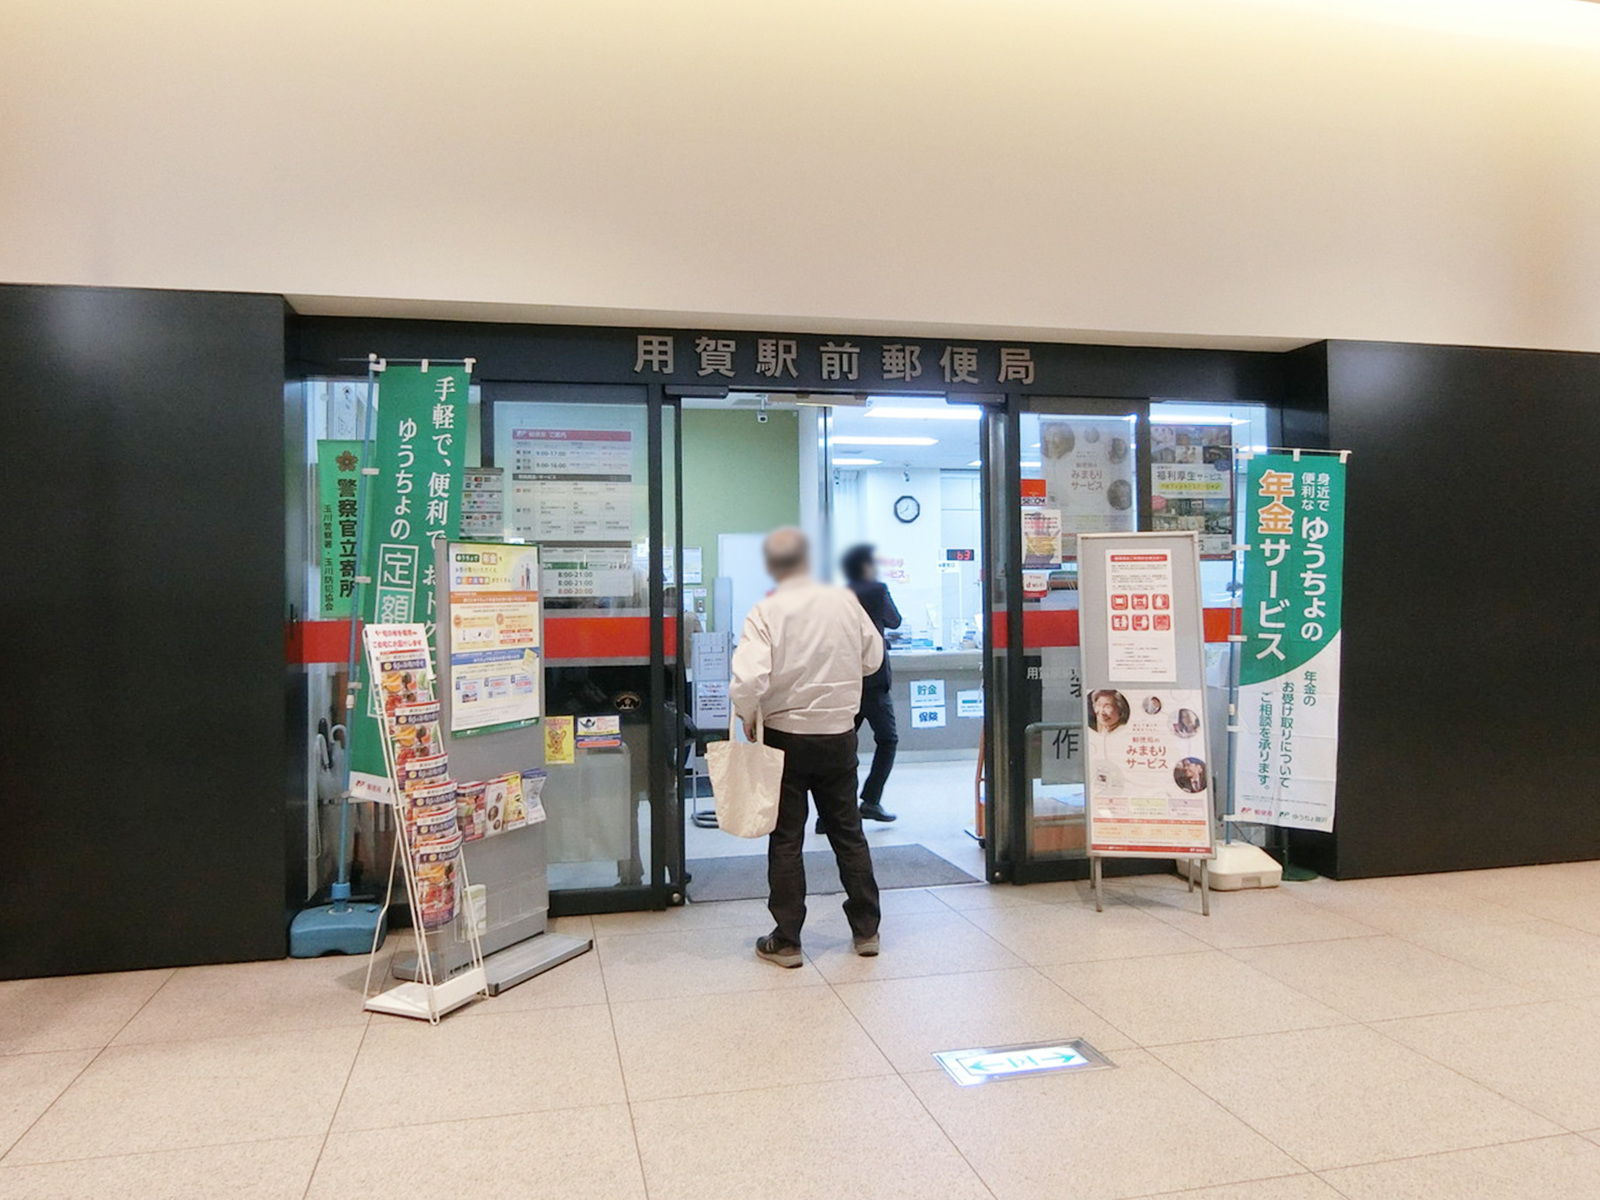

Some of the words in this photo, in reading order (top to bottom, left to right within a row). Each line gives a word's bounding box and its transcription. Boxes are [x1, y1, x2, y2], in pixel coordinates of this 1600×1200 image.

[633, 335, 1036, 385] 用賀駅前郵便局
[1071, 469, 1103, 479] みまもり
[1071, 480, 1104, 490] サービス
[1301, 472, 1315, 511] 便利な
[1316, 472, 1331, 512] 身近で
[337, 478, 358, 599] 警察官立寄所
[1256, 469, 1296, 661] 年金サービス
[1300, 516, 1330, 642] ゆうちょの
[917, 684, 937, 695] 貯金
[1303, 670, 1317, 707] 年金の
[919, 711, 938, 723] 保険
[1279, 681, 1295, 789] お受け取りについて
[1052, 728, 1079, 760] 作
[1126, 745, 1167, 757] みまもり
[1258, 692, 1273, 790] ご相談を承ります。
[1126, 758, 1168, 770] サービス
